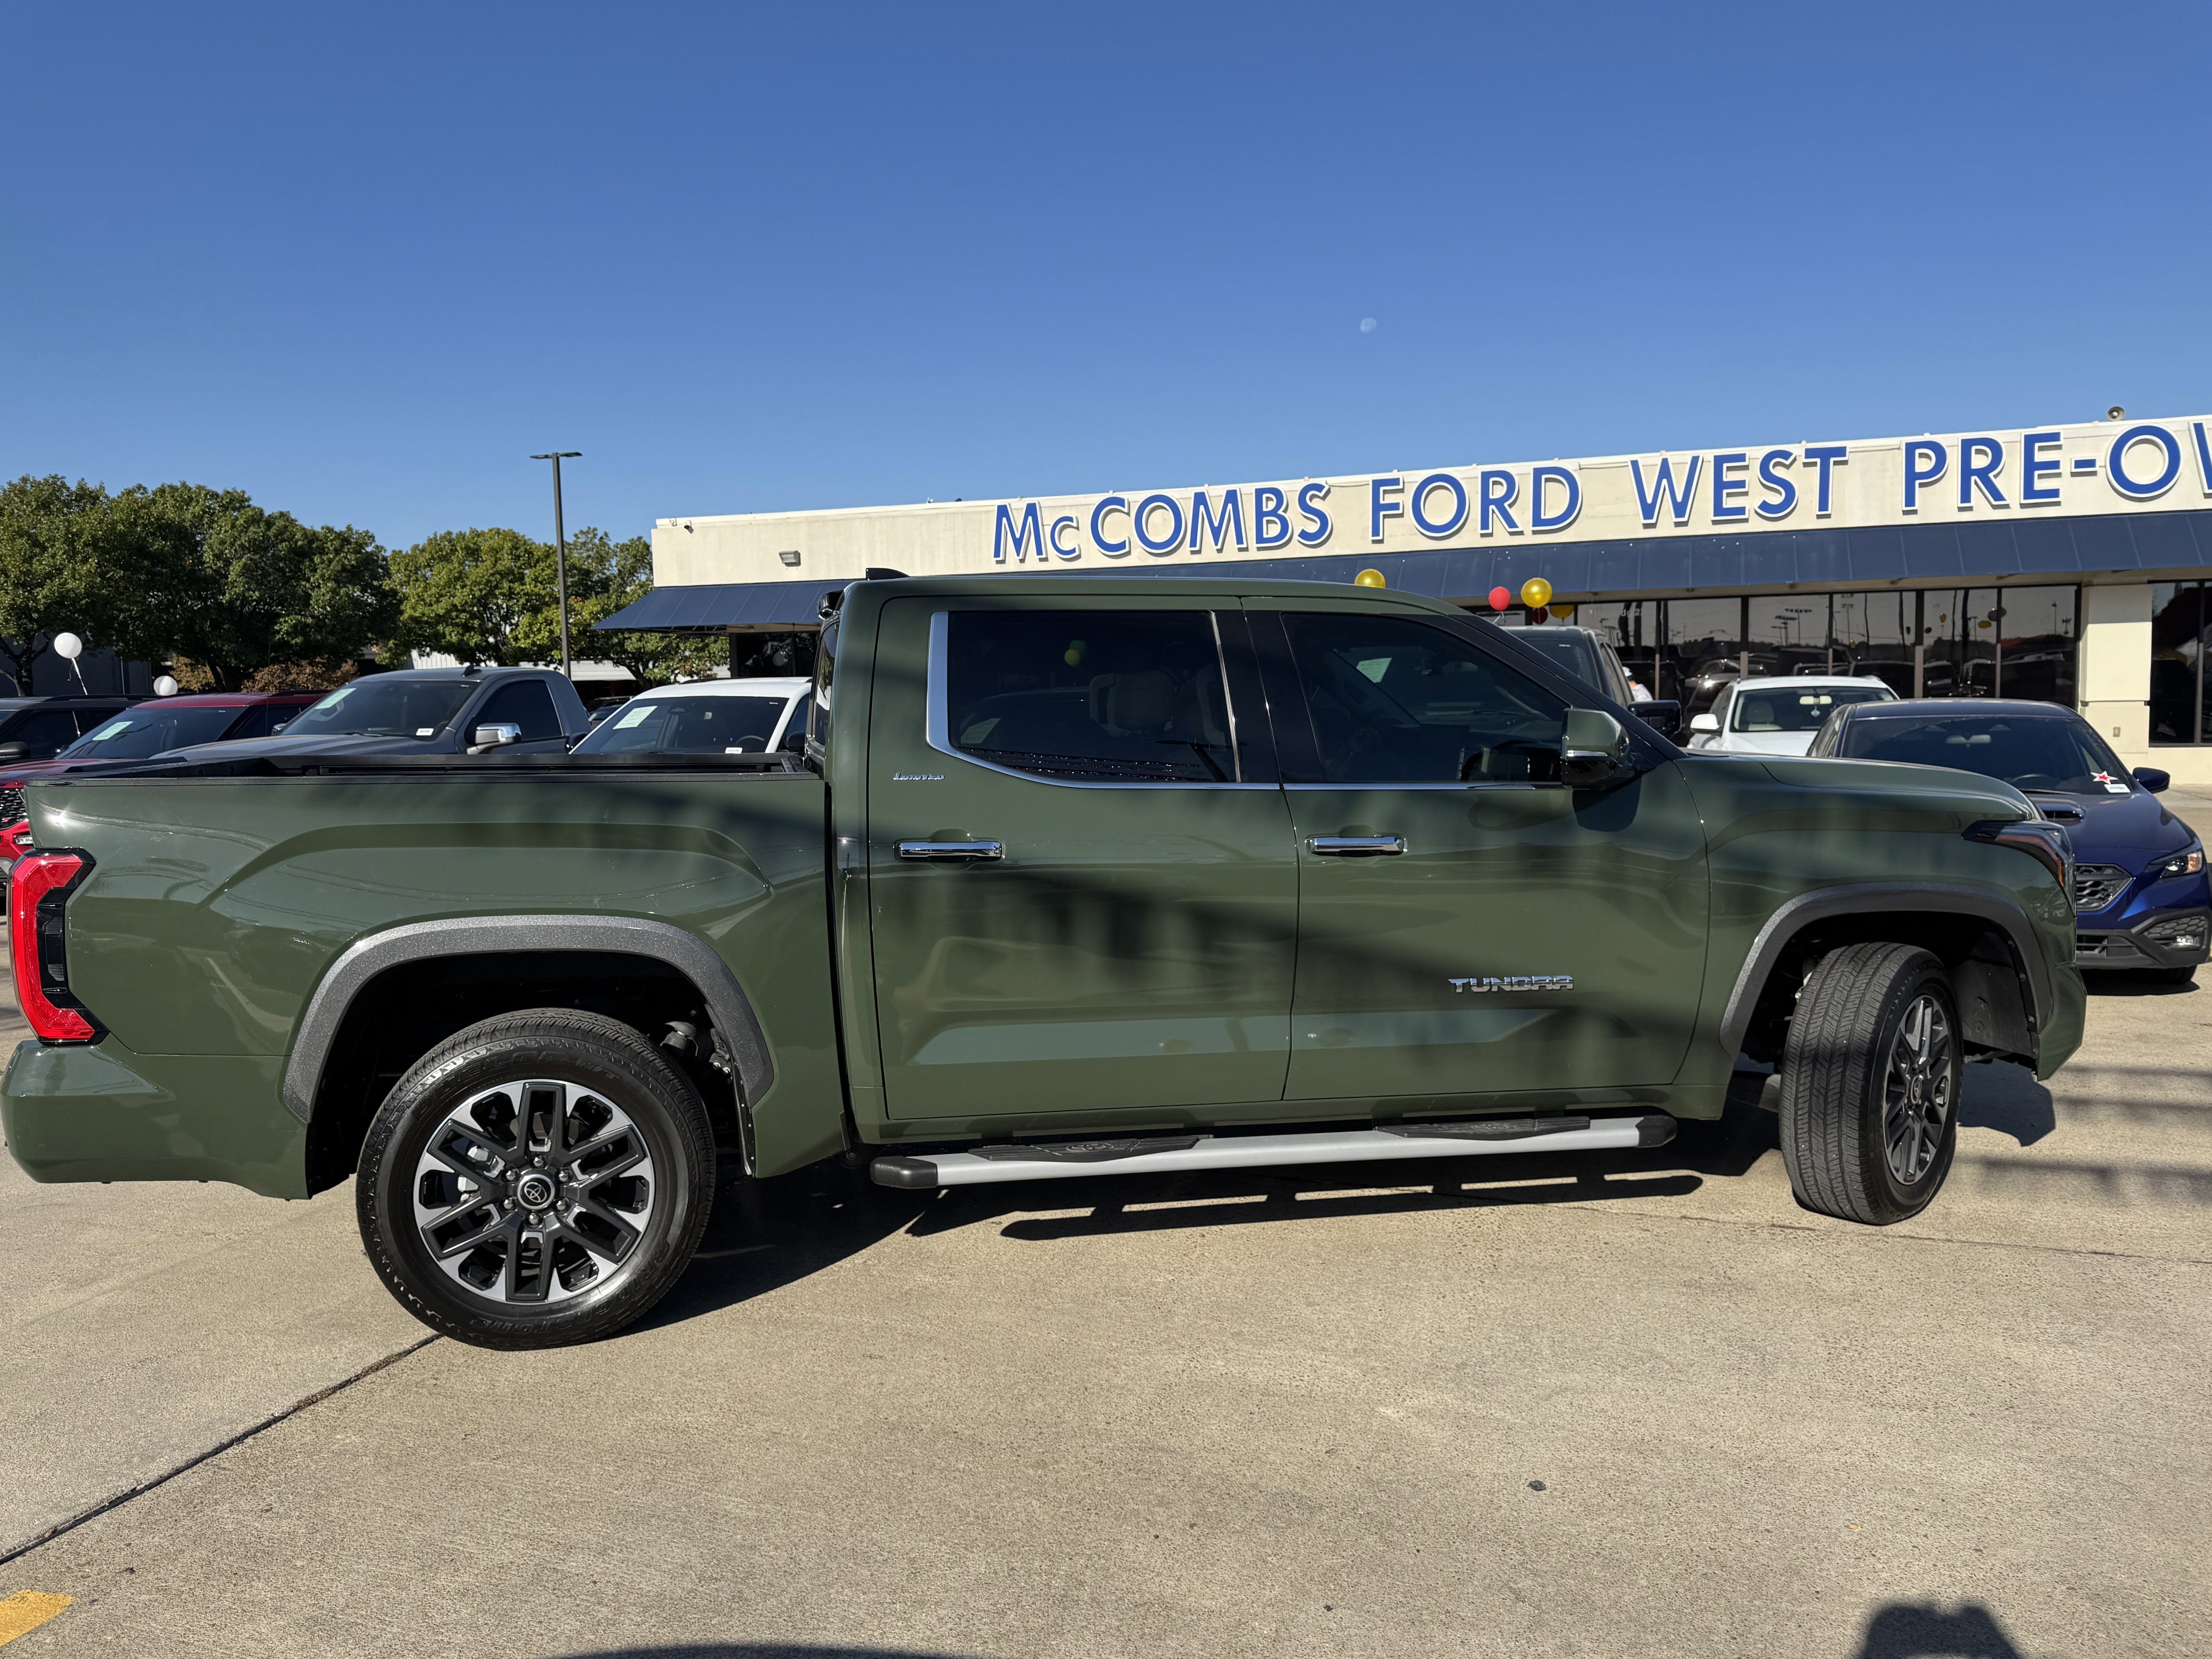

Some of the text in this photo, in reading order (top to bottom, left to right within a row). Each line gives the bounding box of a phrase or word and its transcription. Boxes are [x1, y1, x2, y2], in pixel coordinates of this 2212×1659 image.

[993, 480, 1333, 561] McCOMBS
[1369, 465, 1582, 541] FORD
[1628, 445, 1849, 525] WEST
[1448, 975, 1574, 993] TUNDRA
